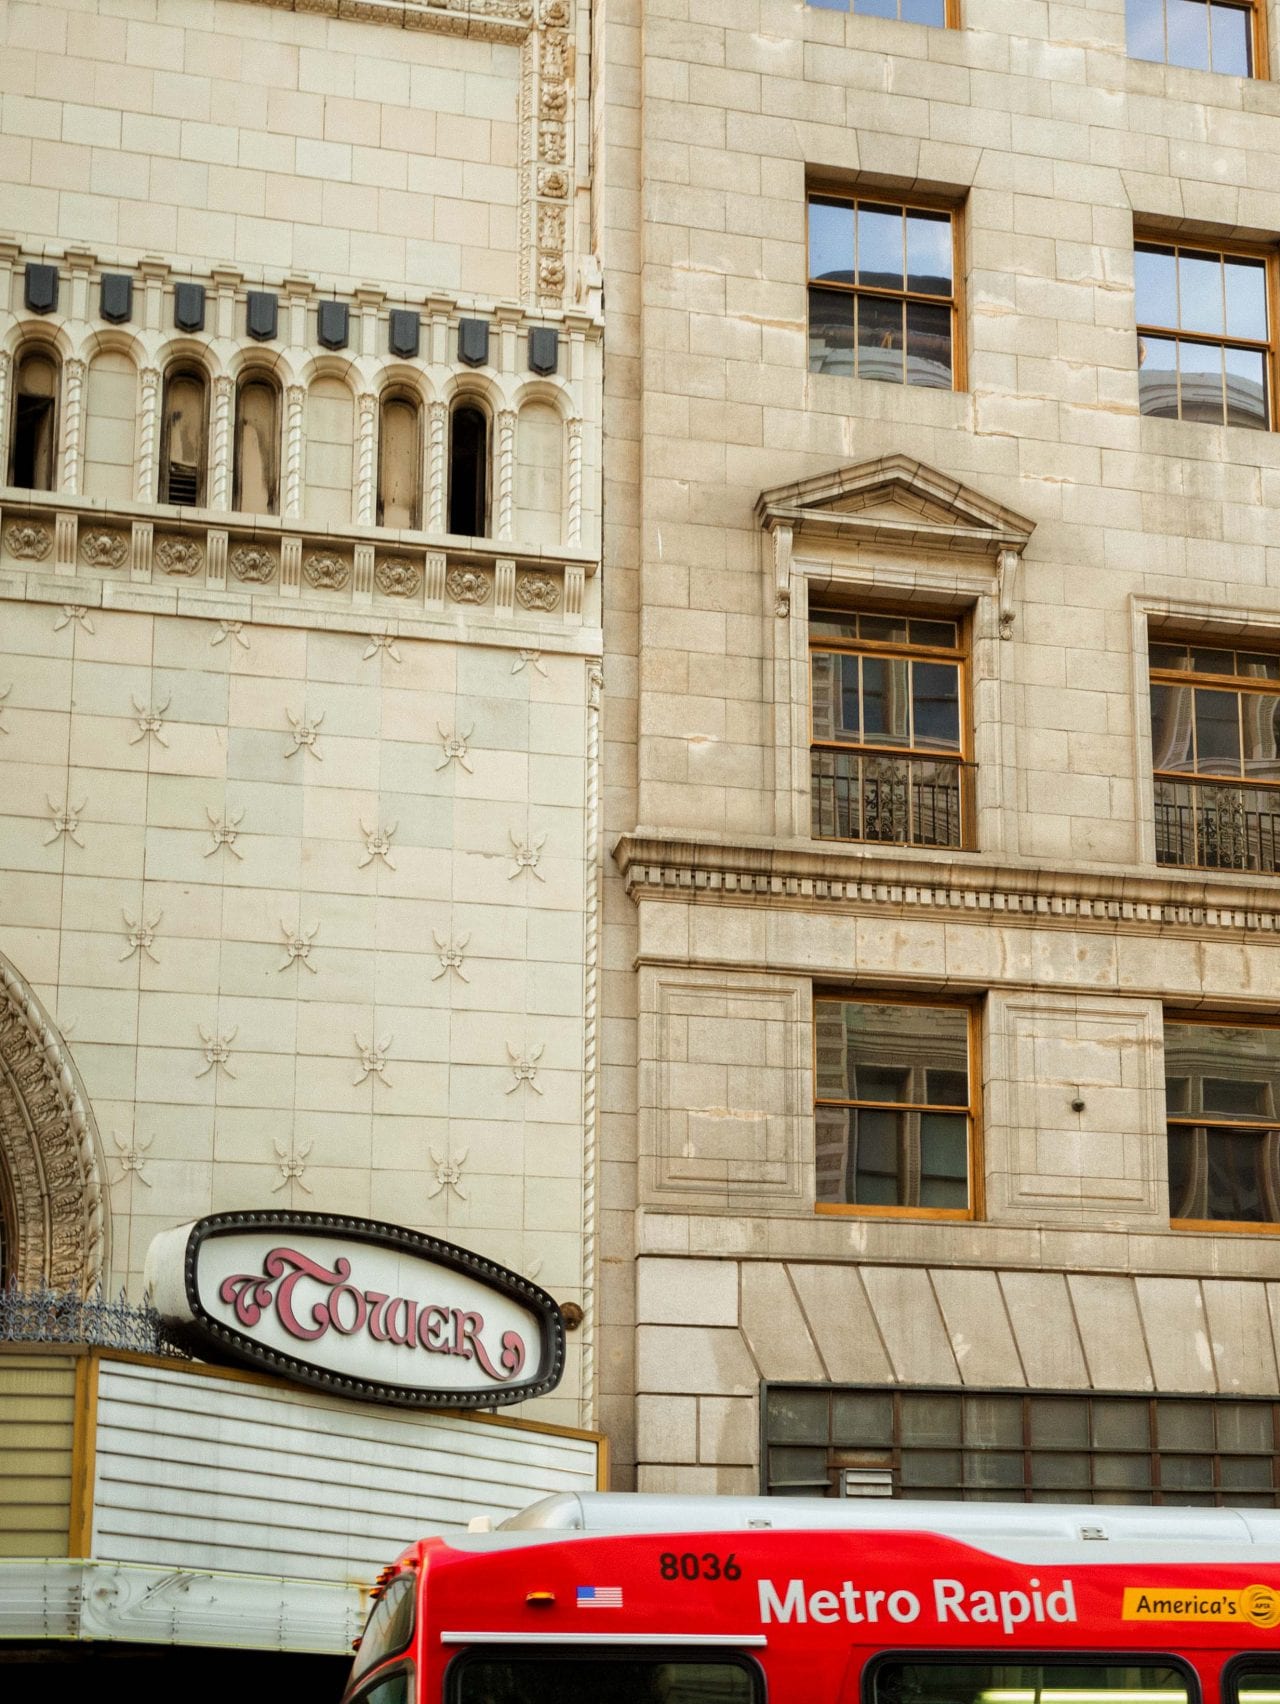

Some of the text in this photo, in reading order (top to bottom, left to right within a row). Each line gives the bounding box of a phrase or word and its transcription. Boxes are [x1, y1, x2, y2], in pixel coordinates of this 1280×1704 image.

[659, 1552, 742, 1581] 8036
[757, 1577, 1078, 1634] Metro Rapid
[1136, 1595, 1237, 1615] America's
